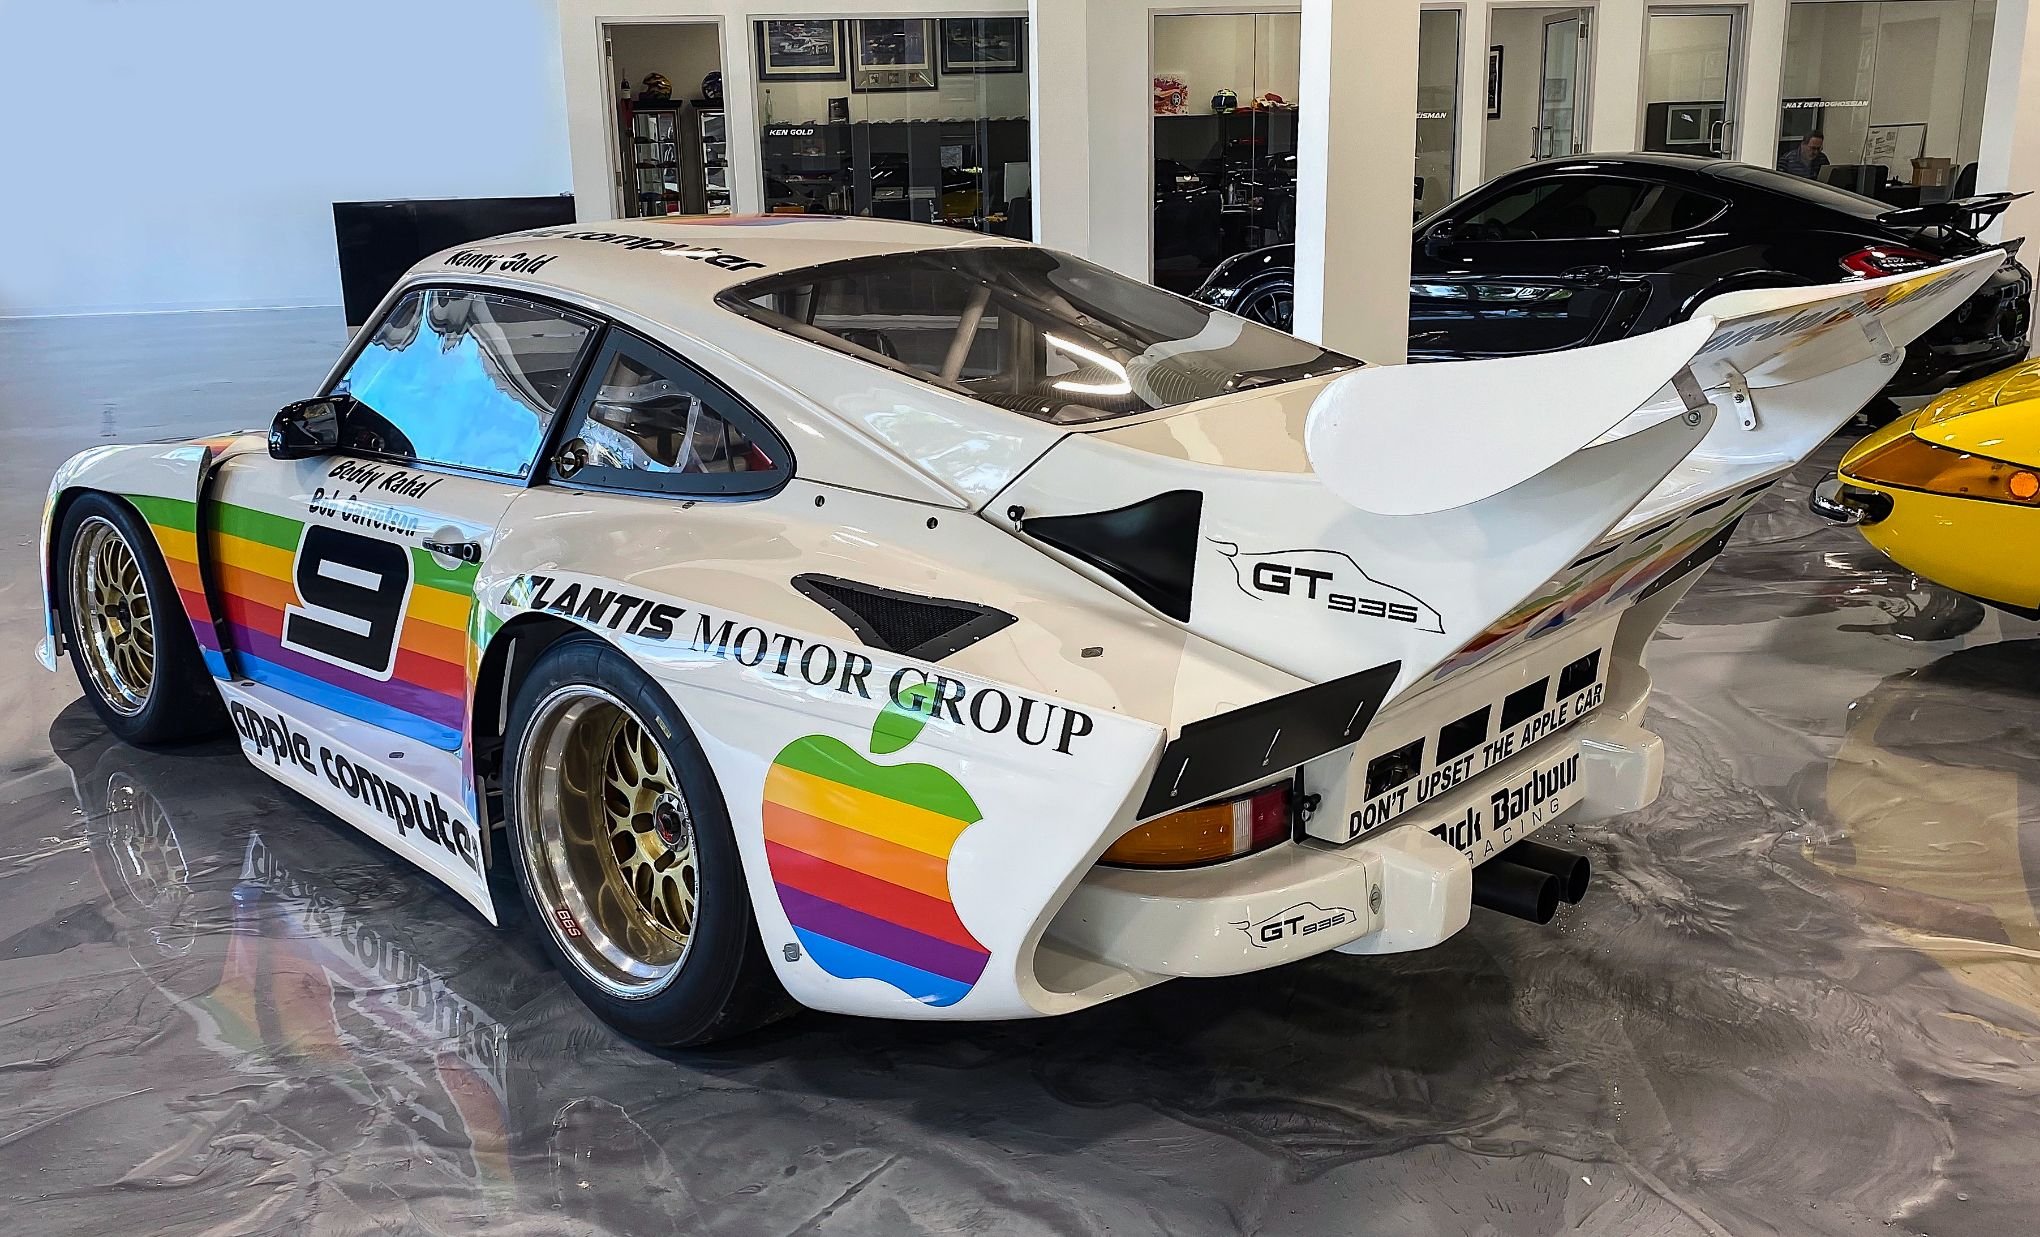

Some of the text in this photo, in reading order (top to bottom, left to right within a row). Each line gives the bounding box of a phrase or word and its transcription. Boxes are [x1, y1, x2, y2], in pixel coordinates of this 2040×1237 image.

[444, 249, 558, 275] Kenny Gold
[309, 487, 419, 537] Bob Garretson
[378, 471, 445, 499] Rahal
[287, 523, 411, 674] 9
[1253, 562, 1419, 624] GT 935
[500, 574, 1095, 757] ATLANTIS MOTOR GROUP
[230, 700, 317, 776] apple
[1349, 683, 1603, 840] DON'T UPSET THE APPLE CAR
[1491, 753, 1580, 831] Barbour
[1261, 912, 1345, 942] GT 935
